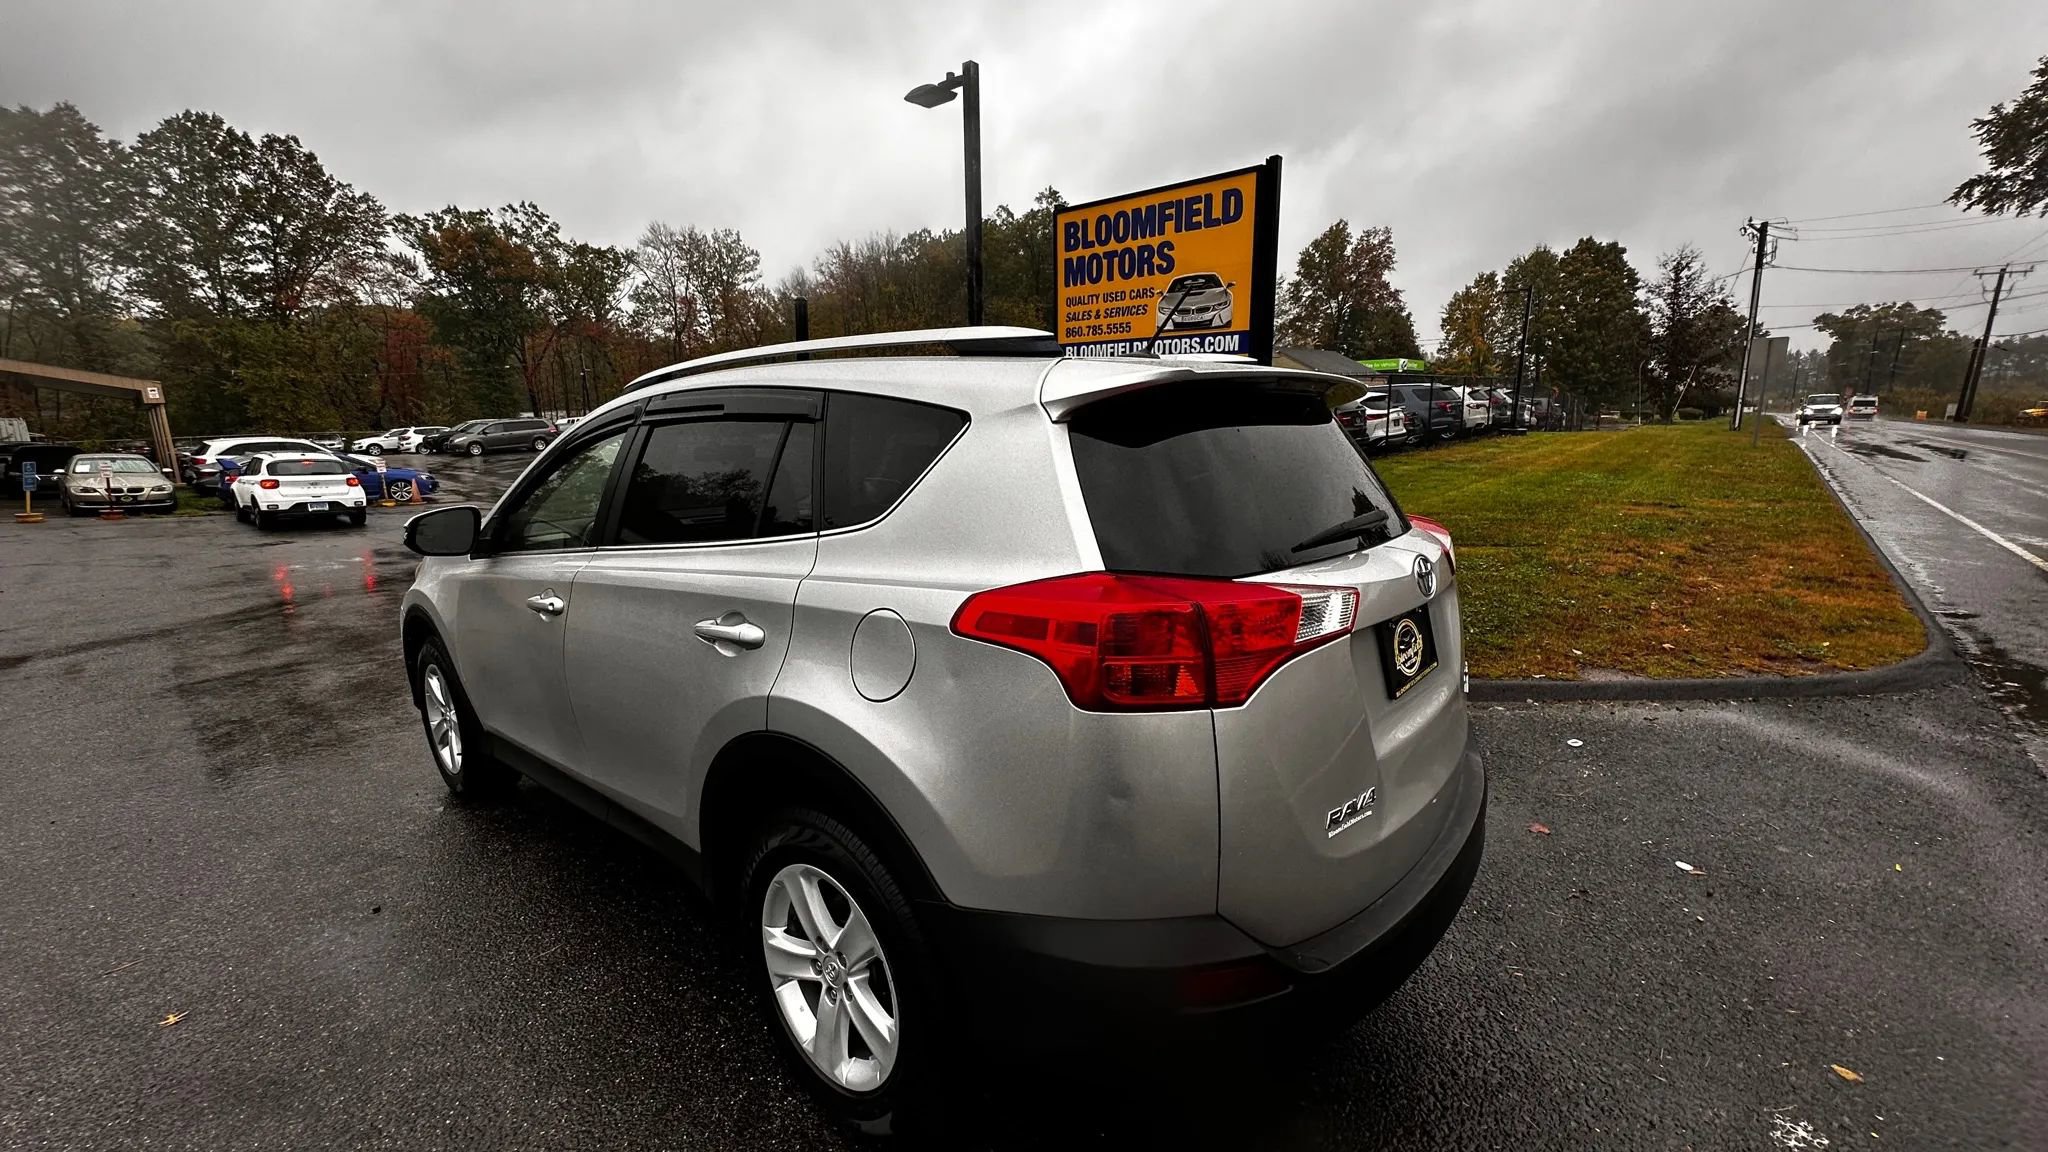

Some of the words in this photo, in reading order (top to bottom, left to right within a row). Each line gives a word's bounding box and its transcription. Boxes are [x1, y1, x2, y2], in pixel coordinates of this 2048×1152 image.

[1064, 187, 1244, 253] BLOOMFIELD
[1063, 241, 1176, 288] MOTORS
[1065, 293, 1101, 308] QUALITY
[1102, 290, 1127, 304] USED
[1129, 287, 1155, 301] CARS
[1065, 309, 1093, 323] SALES
[1094, 309, 1101, 320] &
[1103, 303, 1149, 319] SERVICES
[1065, 321, 1132, 338] 860.785.5555
[1325, 786, 1377, 829] RAV4
